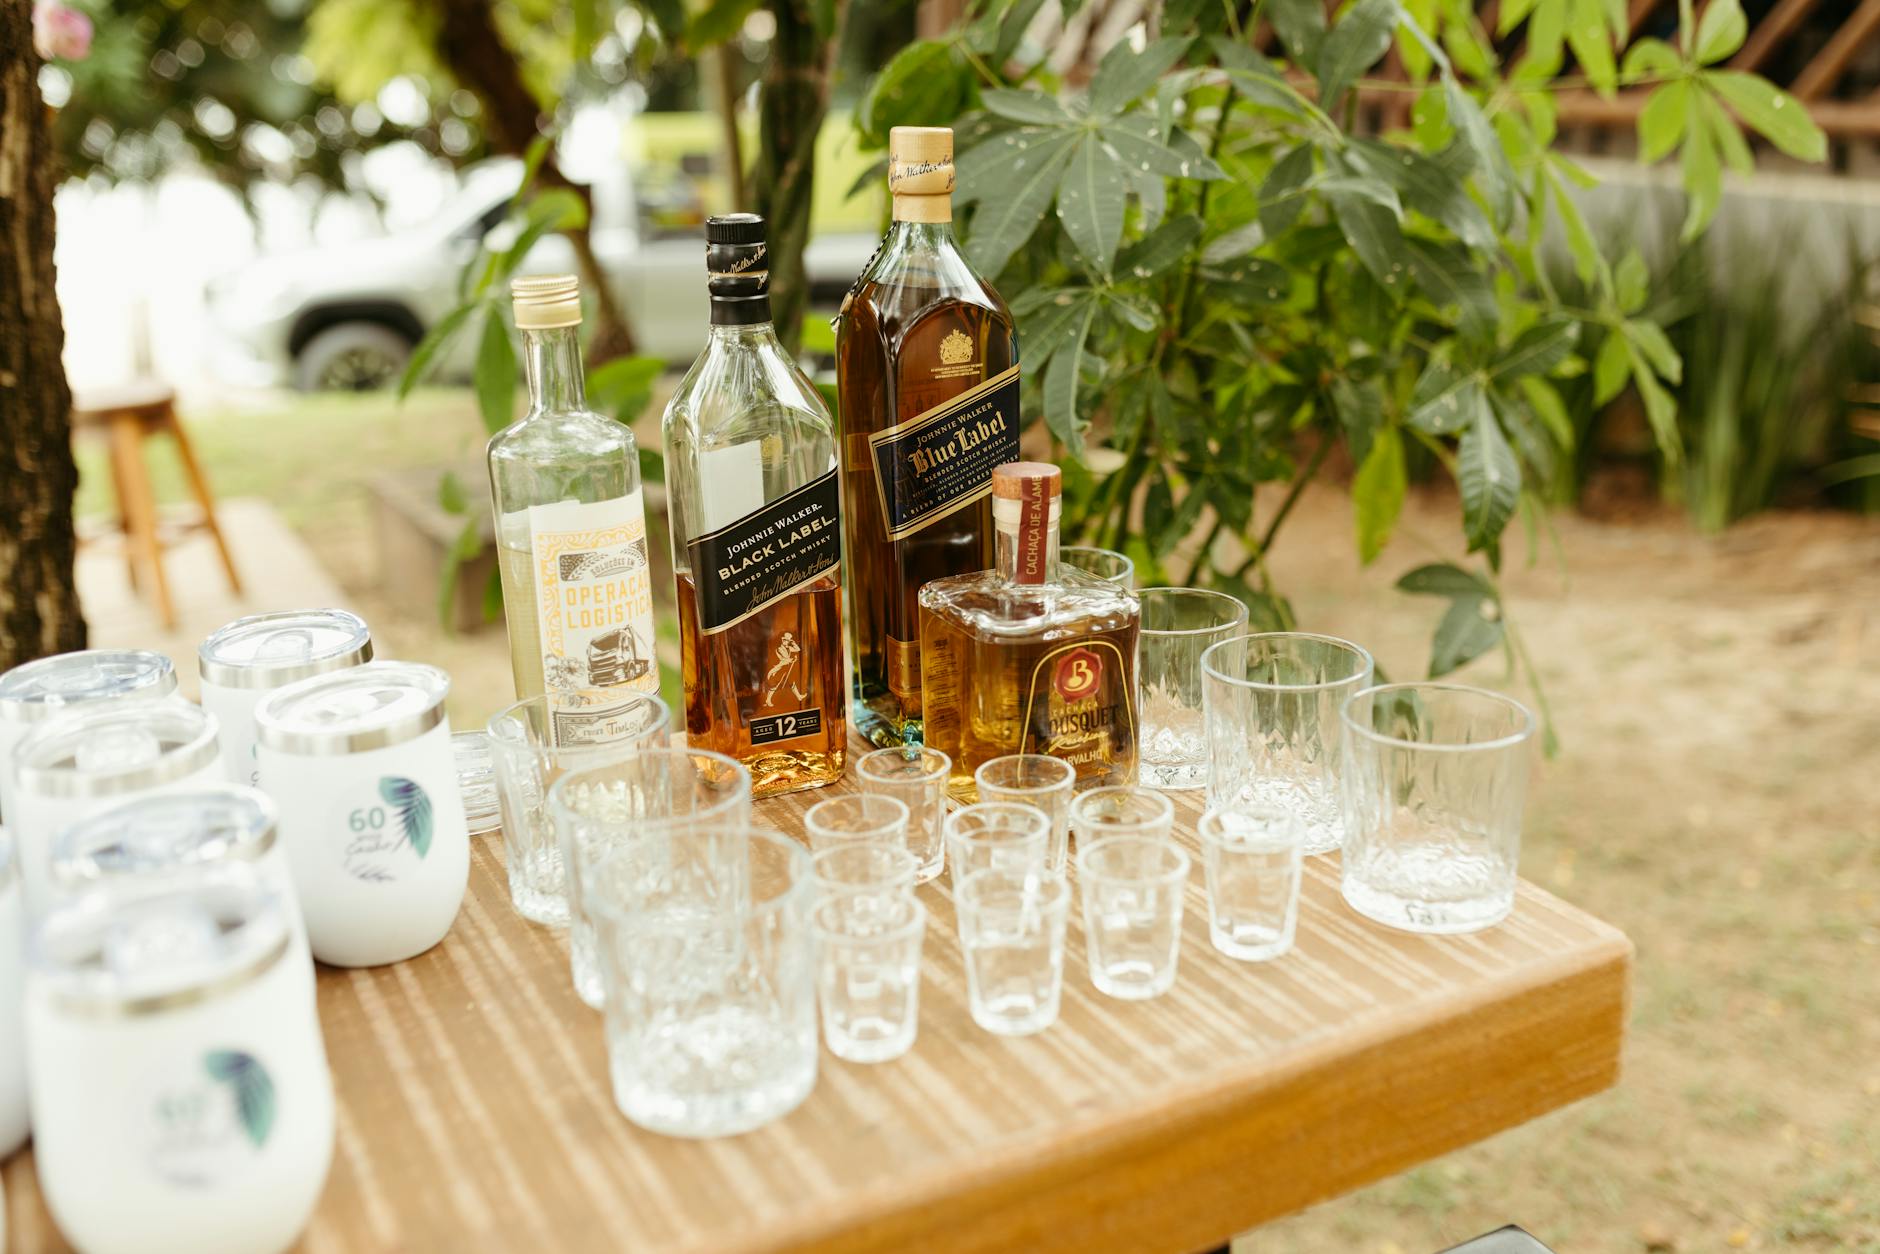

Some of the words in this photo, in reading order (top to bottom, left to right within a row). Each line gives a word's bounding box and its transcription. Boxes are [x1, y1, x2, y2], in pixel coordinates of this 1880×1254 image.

[905, 160, 938, 178] Walker
[908, 441, 958, 478] Blue
[953, 410, 1007, 455] Label
[916, 420, 958, 447] JOHNNIE
[957, 402, 993, 424] WALKER
[924, 464, 954, 483] BLENDED
[956, 450, 981, 467] SCOTCH
[982, 437, 1007, 453] WHISKY
[937, 493, 947, 501] OF
[949, 484, 964, 495] OUR
[967, 467, 993, 485] RAREST
[727, 526, 775, 560] JOHNNIE
[774, 503, 819, 530] WALKER
[1029, 512, 1042, 527] DE
[718, 543, 776, 581] BLACK
[778, 516, 833, 549] LABEL
[723, 571, 762, 596] BLENDED
[765, 555, 797, 573] SCOTCH
[799, 535, 832, 555] WHISKY
[1025, 528, 1041, 576] CACHAÇA
[745, 583, 776, 614] John
[772, 567, 811, 593] Walker
[755, 726, 773, 734] AGED
[775, 716, 797, 737] 12
[798, 718, 817, 726] YEARS
[348, 806, 386, 832] 60
